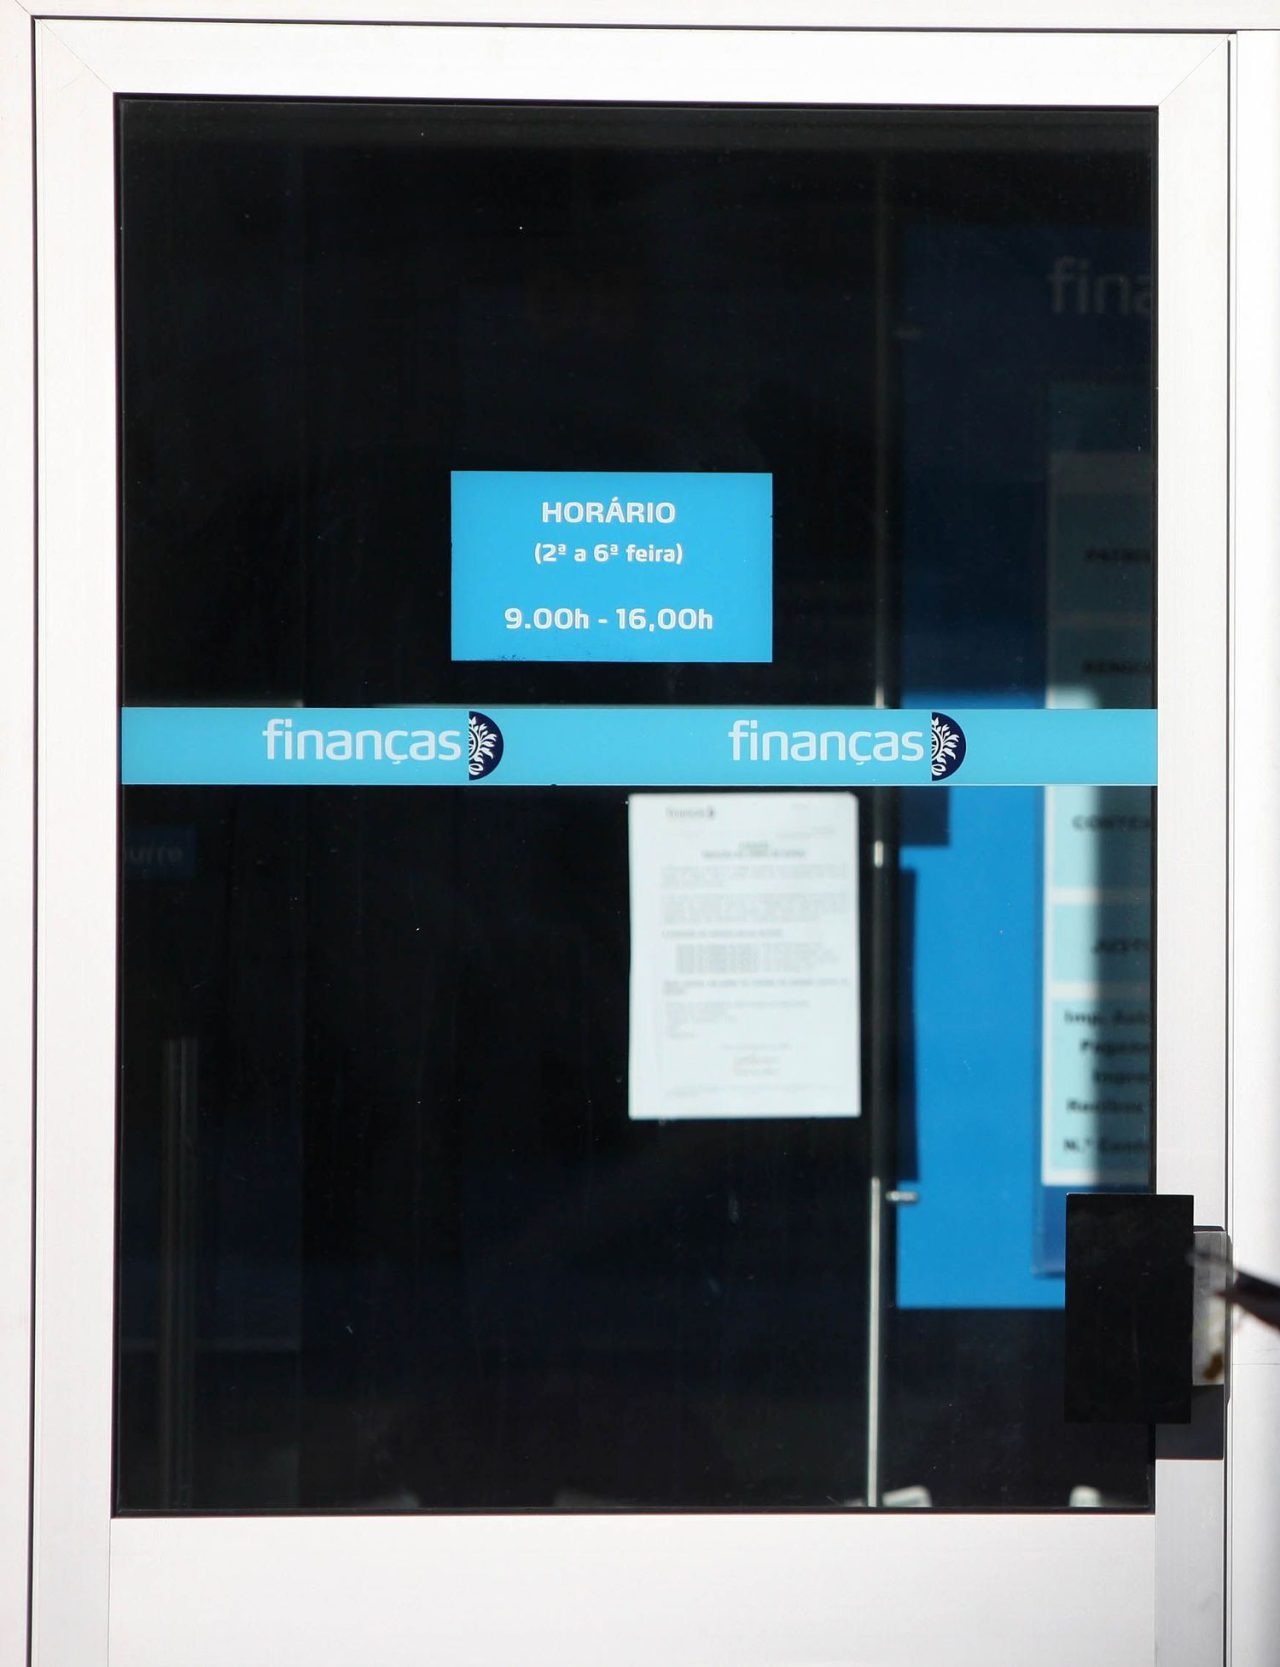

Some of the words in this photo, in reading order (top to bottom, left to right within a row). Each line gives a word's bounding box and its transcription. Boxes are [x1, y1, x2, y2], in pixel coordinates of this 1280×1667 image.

[541, 496, 676, 524] HORÁRIO
[574, 546, 587, 562] a
[625, 542, 684, 565] feira)
[504, 607, 590, 630] 9.00h
[615, 607, 714, 632] 16,00h
[261, 718, 463, 765] finanças
[728, 719, 925, 766] finanças
